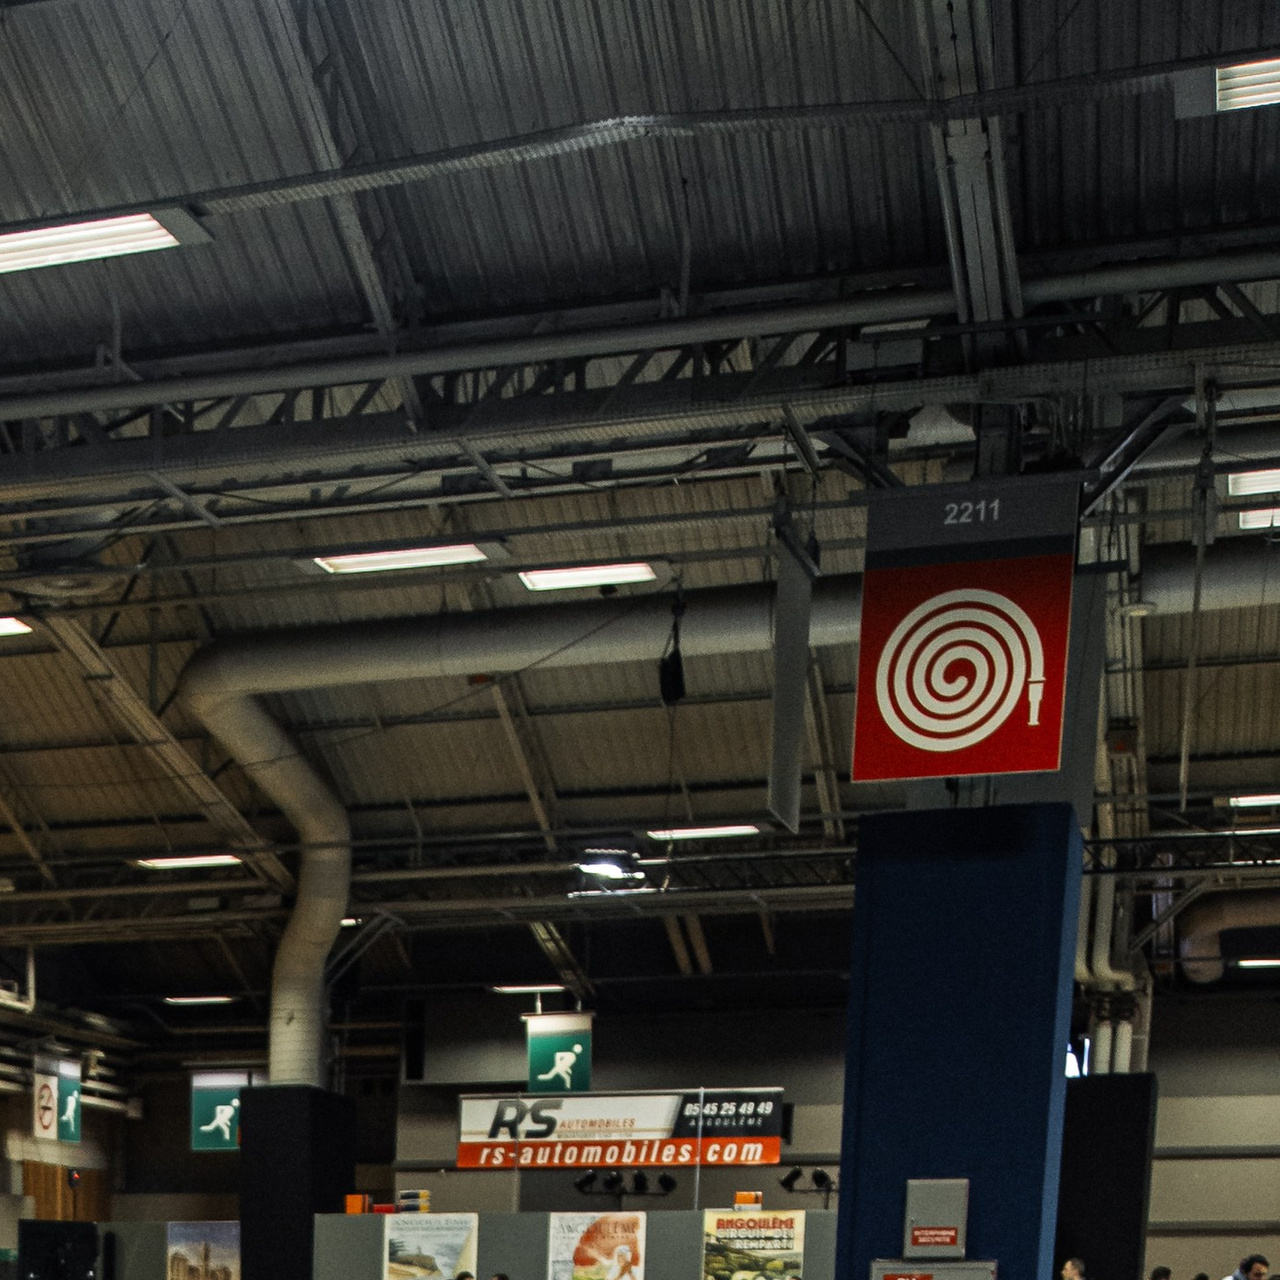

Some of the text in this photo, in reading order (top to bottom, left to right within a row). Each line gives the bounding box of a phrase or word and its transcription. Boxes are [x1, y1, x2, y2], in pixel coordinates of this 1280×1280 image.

[944, 499, 999, 525] 2211
[488, 1099, 564, 1139] RS
[683, 1101, 774, 1116] 05 45 25 49 49
[559, 1118, 636, 1129] AUTOMOBILES
[479, 1139, 764, 1165] rs-automobiles.com
